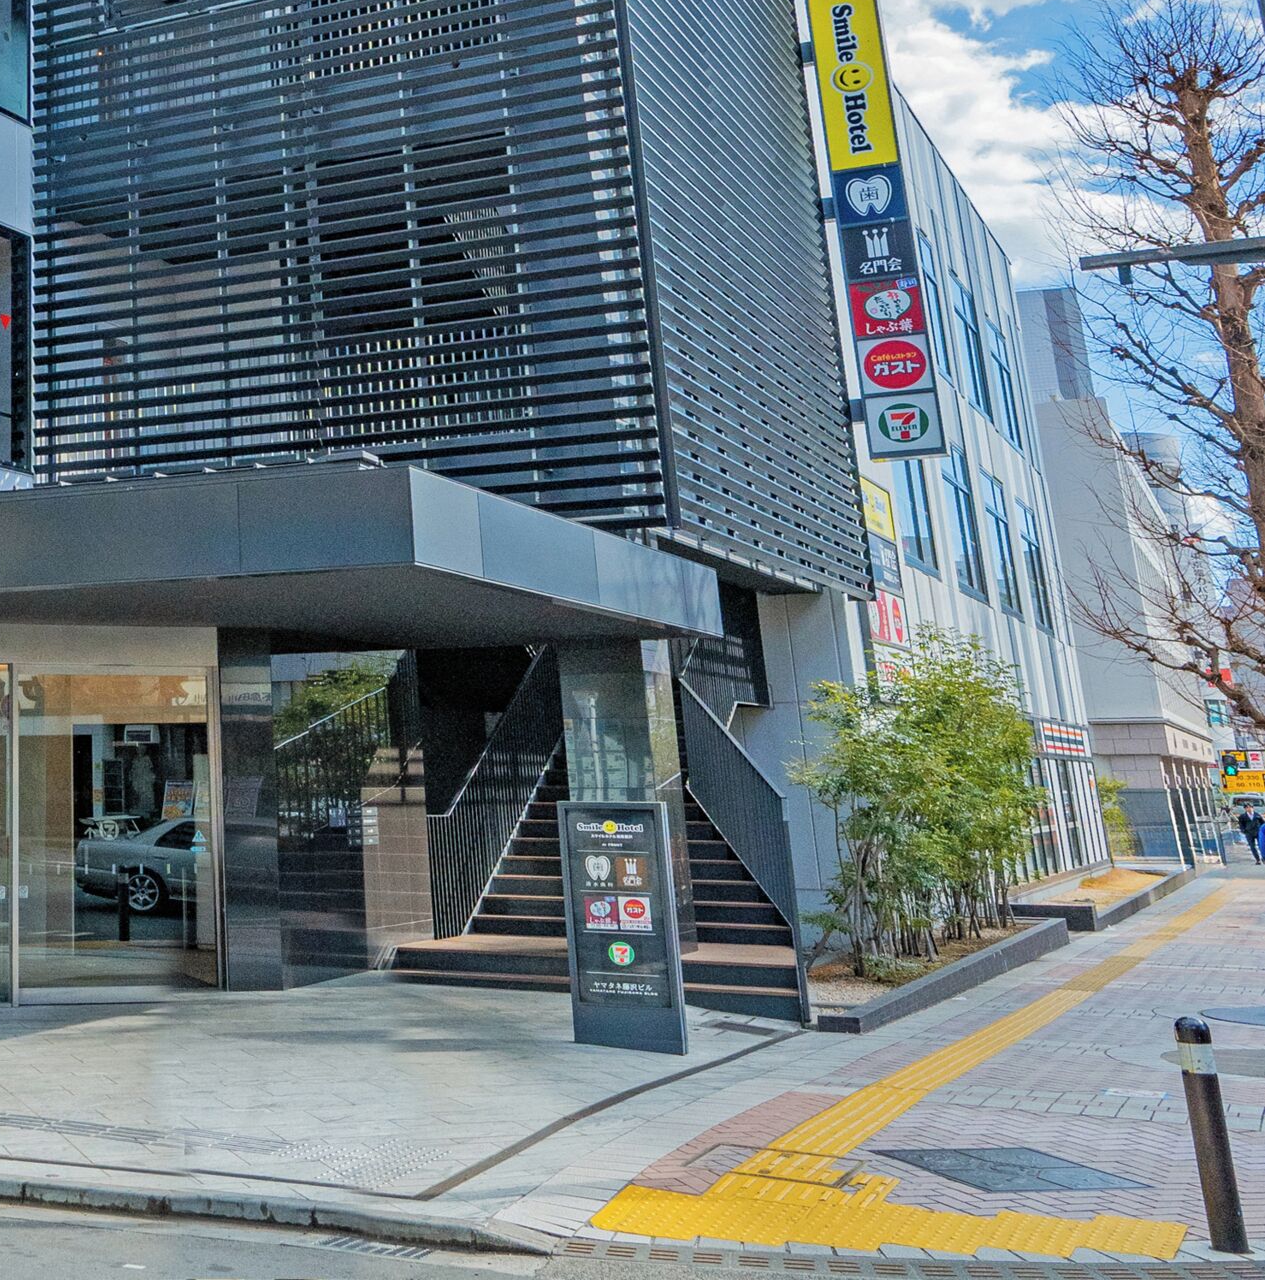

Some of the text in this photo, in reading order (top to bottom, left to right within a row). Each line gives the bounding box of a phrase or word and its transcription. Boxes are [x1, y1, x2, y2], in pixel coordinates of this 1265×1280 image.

[832, 4, 872, 154] Smile Hotel
[859, 186, 880, 202] 歯
[859, 257, 902, 275] 名門会
[874, 360, 921, 377] ガスト
[577, 822, 644, 833] Smile Hotel
